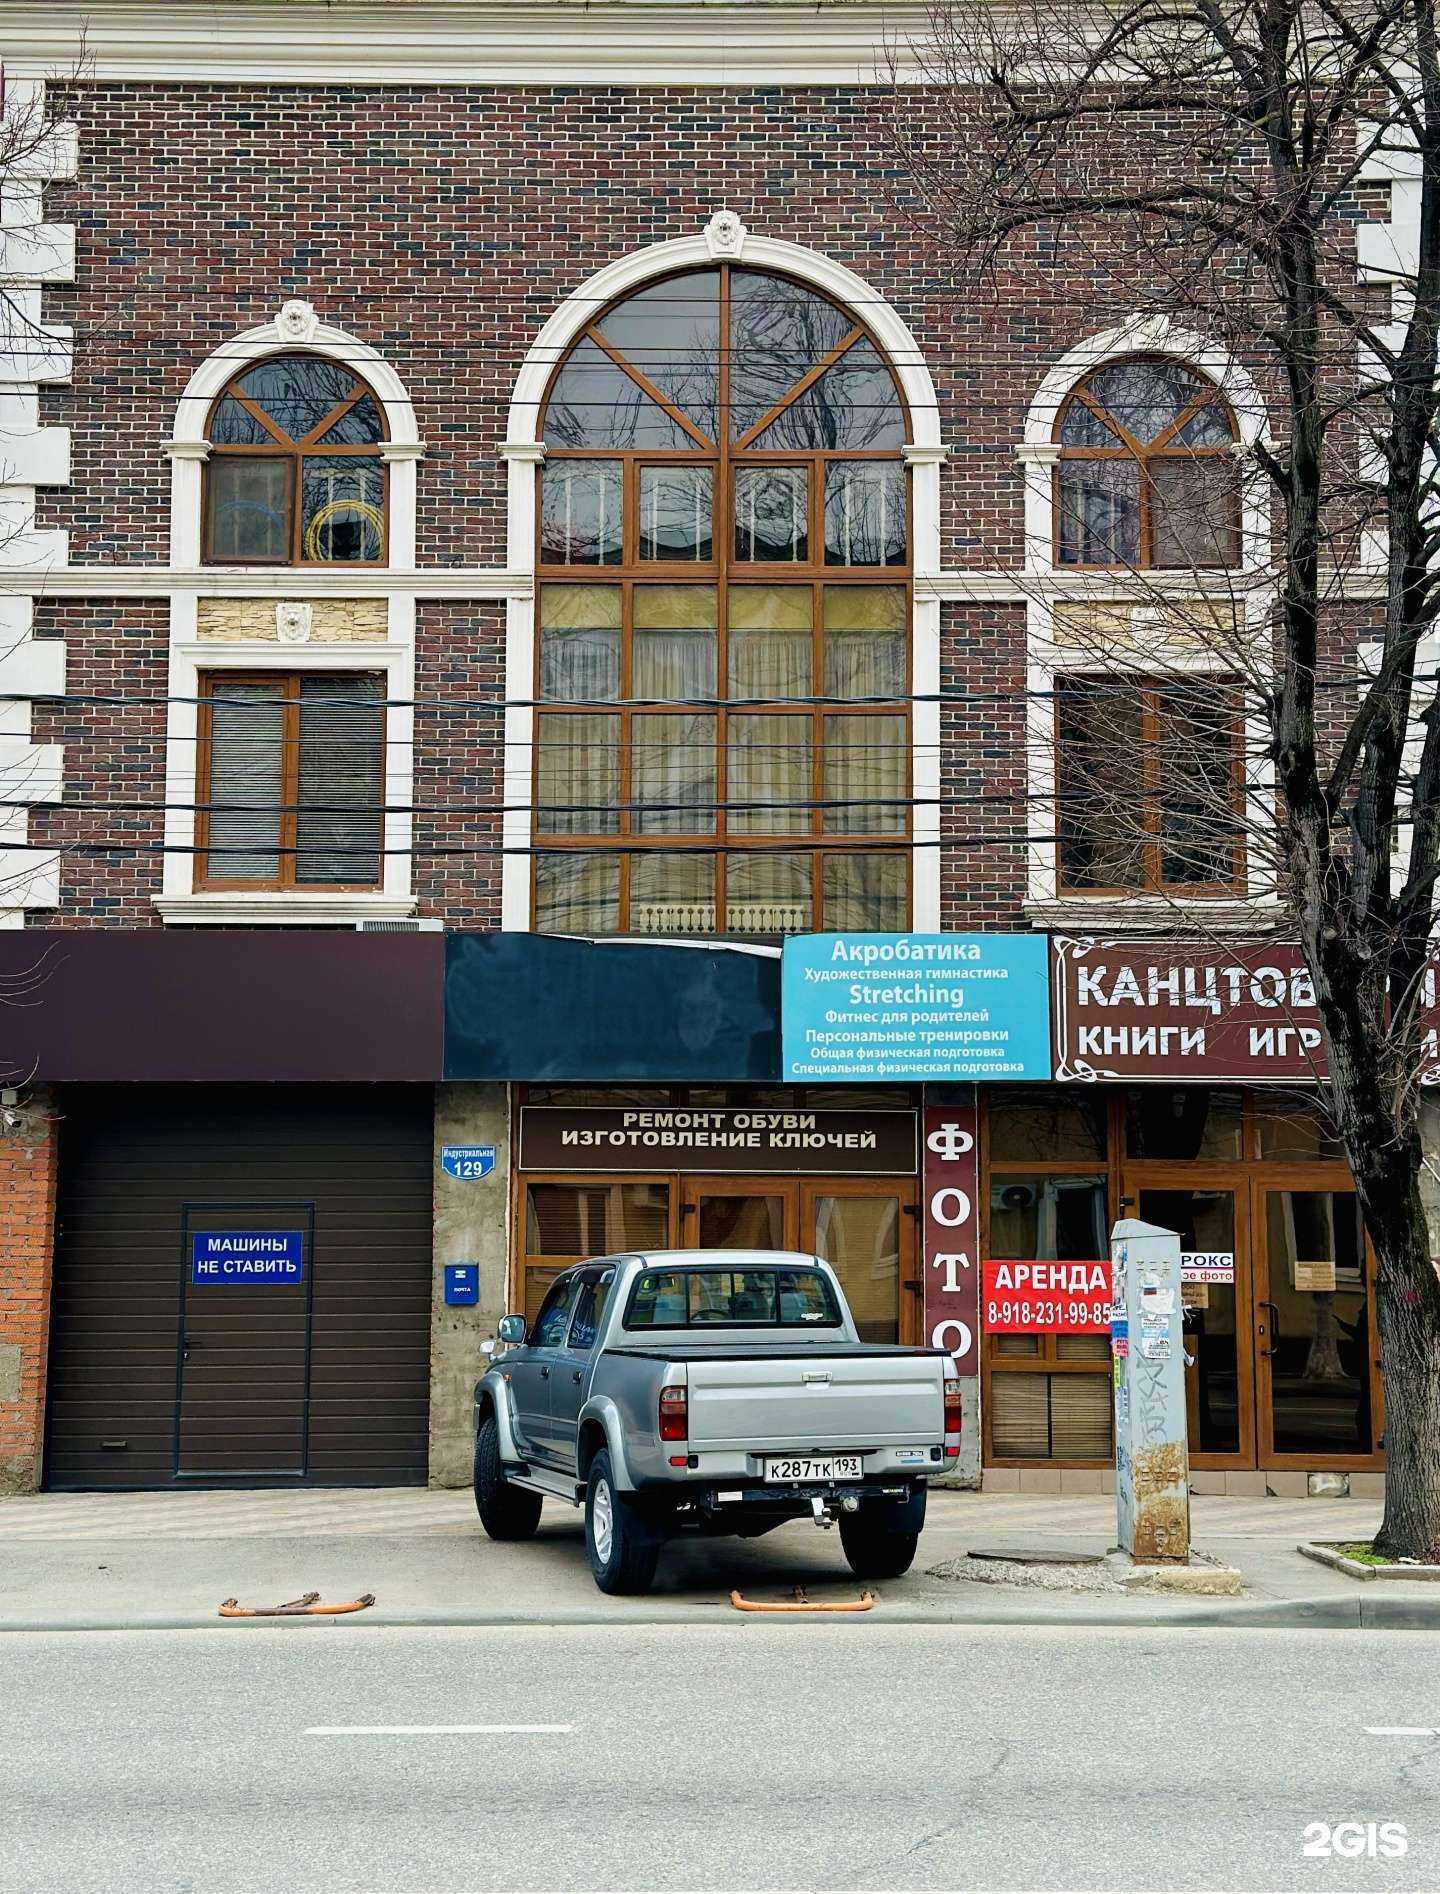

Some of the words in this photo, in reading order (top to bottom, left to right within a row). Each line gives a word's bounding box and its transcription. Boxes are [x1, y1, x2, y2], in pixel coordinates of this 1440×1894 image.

[831, 939, 981, 966] Акробатика
[804, 967, 922, 983] Художественная
[926, 968, 1009, 979] гимнастика
[849, 984, 964, 1009] Stretching
[1077, 966, 1436, 1014] КАНЦТОВ
[825, 1010, 879, 1023] Фитнес
[881, 1012, 908, 1025] для
[911, 1009, 989, 1025] родителей
[806, 1029, 916, 1045] Персональные
[920, 1030, 1009, 1044] тренировки
[1078, 1026, 1206, 1056] КНИГИ
[811, 1047, 853, 1060] Общая
[856, 1047, 931, 1060] физическая
[934, 1048, 1005, 1059] подготовка
[792, 1062, 874, 1076] Специальная
[877, 1061, 951, 1075] физическая
[954, 1062, 1025, 1073] подготовка
[623, 1112, 726, 1128] РЕМОНТ
[733, 1114, 816, 1129] ОБУВИ
[561, 1130, 762, 1148] ИЗГОТОВЛЕНИЕ
[769, 1130, 877, 1149] КЛЮЧЕЙ
[443, 1148, 494, 1160] Индустриальная
[454, 1161, 482, 1176] 129
[208, 1238, 287, 1251] МАШИНЫ
[927, 1123, 973, 1359] ФОТО
[197, 1260, 219, 1273] НЕ
[223, 1260, 297, 1273] СТАВИТЬ
[1181, 1255, 1232, 1266] РОКС
[995, 1264, 1107, 1295] АРЕНДА
[1200, 1270, 1233, 1281] фото
[988, 1301, 1112, 1325] 8-918-231-99-85
[771, 1460, 831, 1479] К287ТК
[835, 1458, 857, 1472] 193
